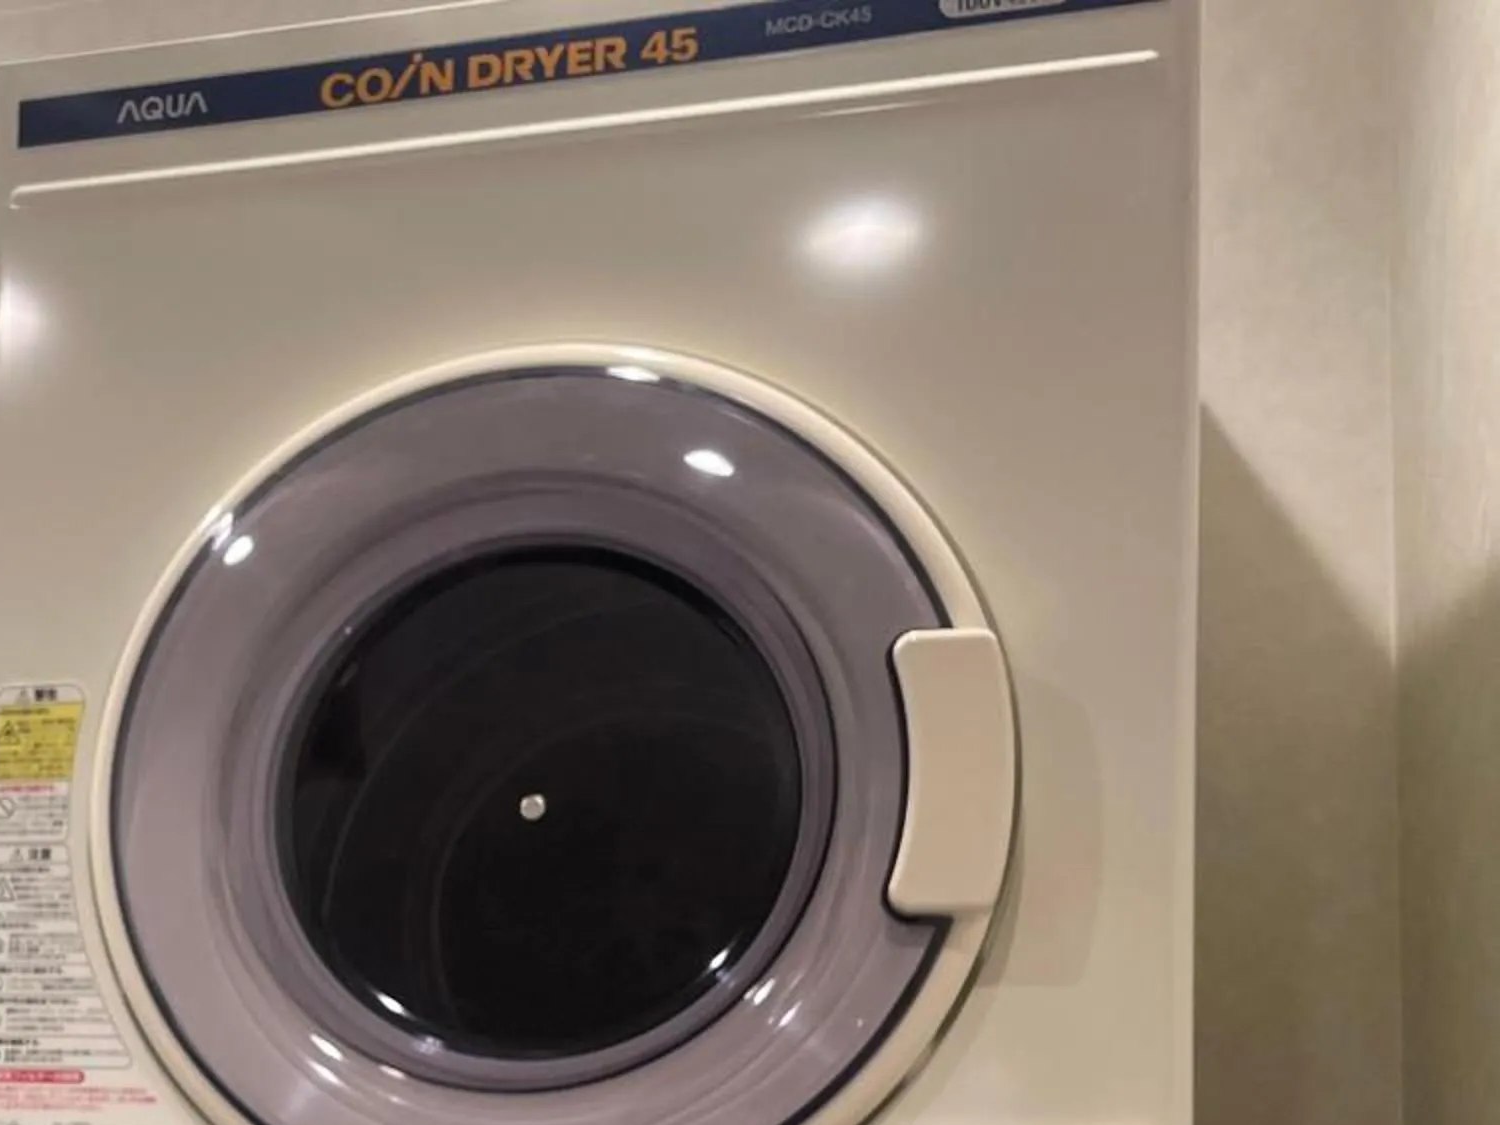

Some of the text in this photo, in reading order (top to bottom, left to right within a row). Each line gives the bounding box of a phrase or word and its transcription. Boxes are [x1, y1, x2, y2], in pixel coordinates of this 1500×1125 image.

[466, 34, 628, 90] DRYER
[639, 26, 699, 64] 45
[116, 90, 208, 124] AQUA
